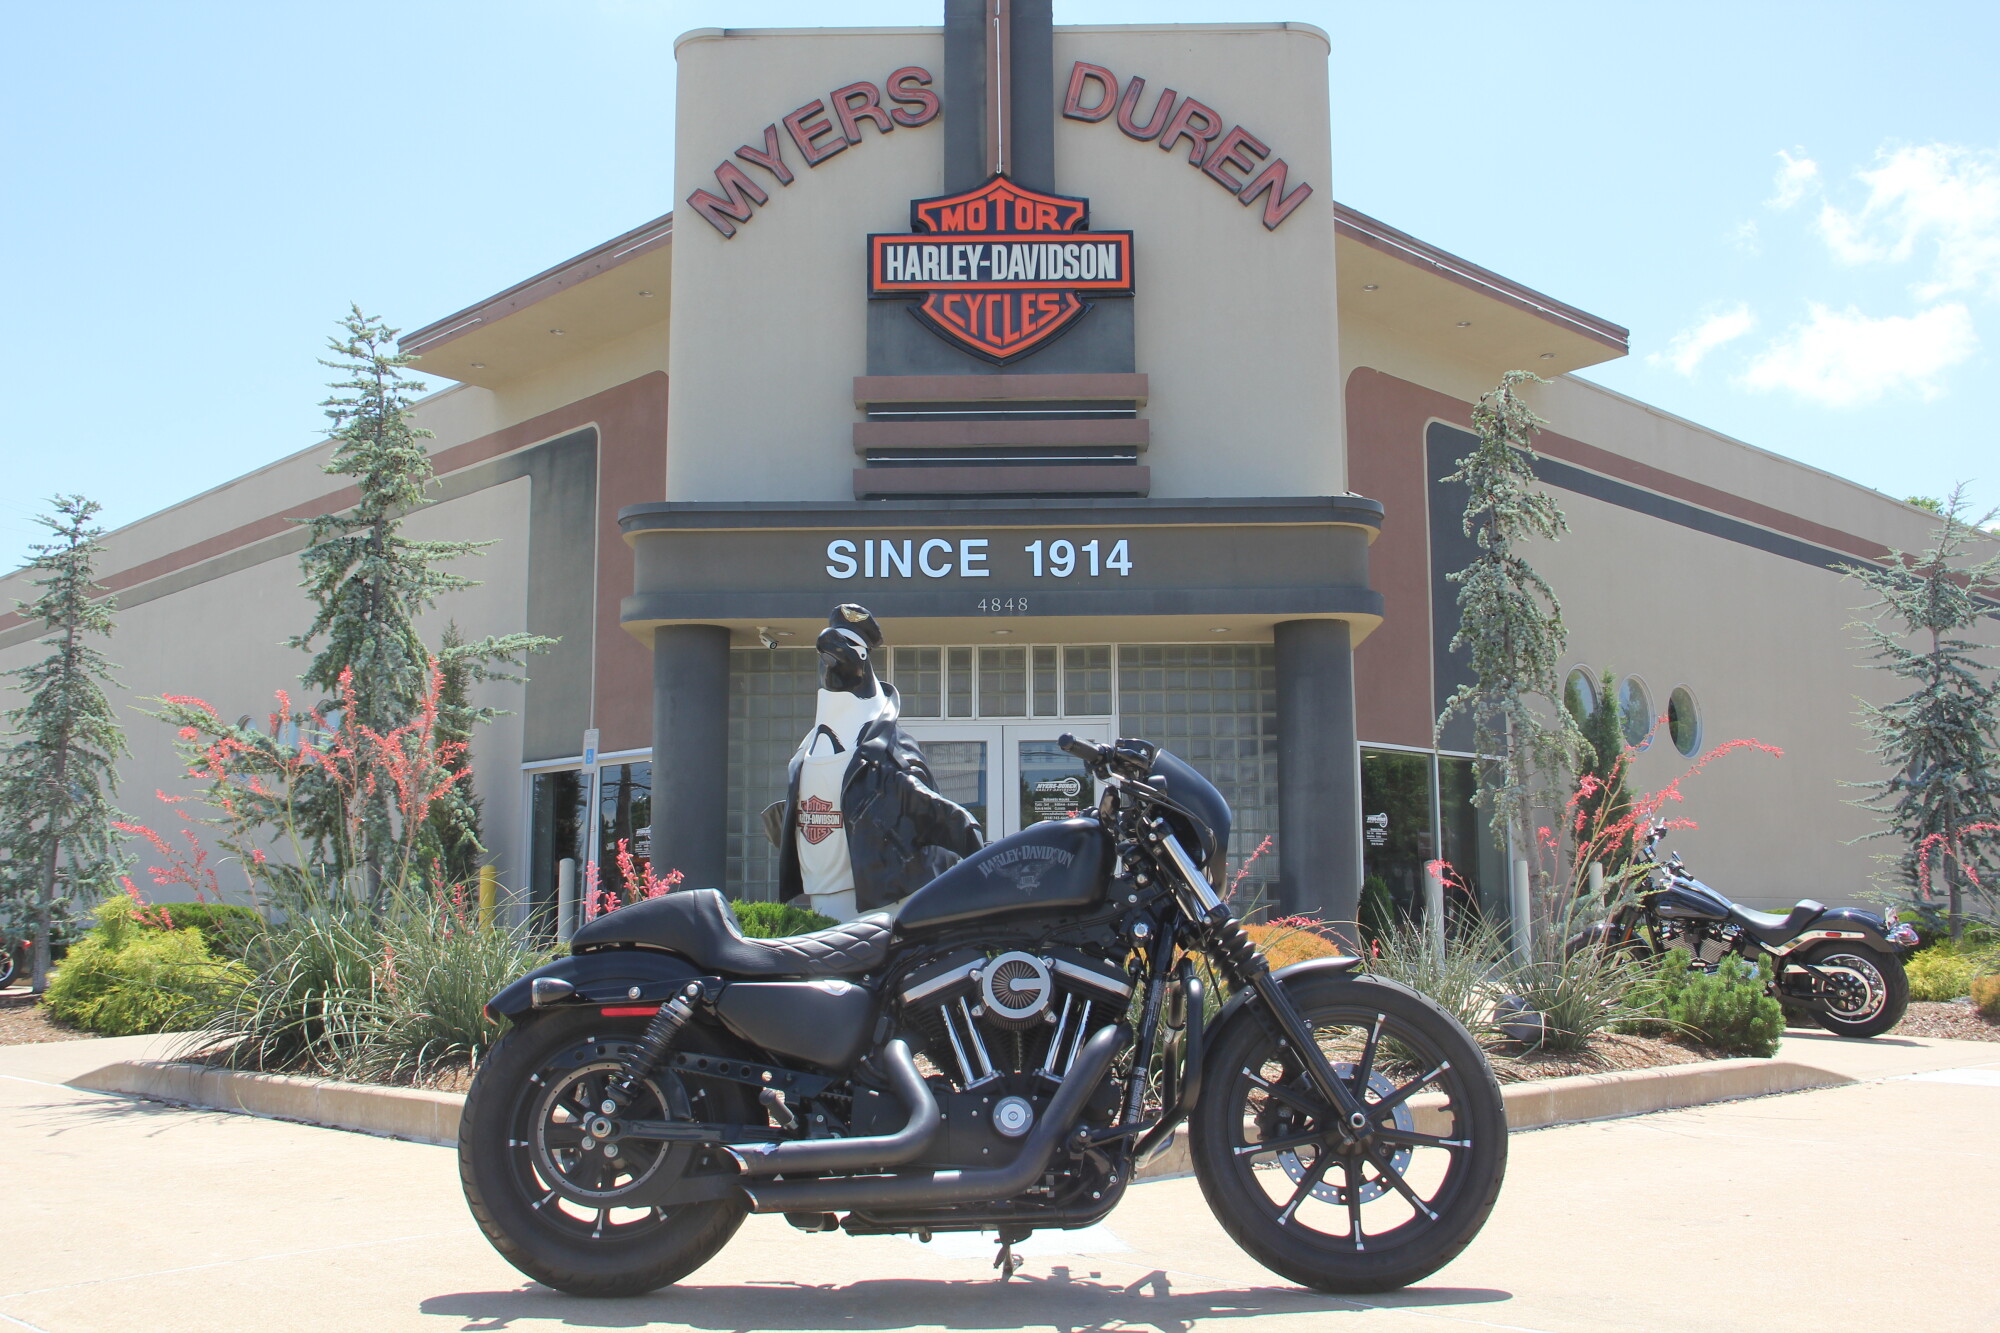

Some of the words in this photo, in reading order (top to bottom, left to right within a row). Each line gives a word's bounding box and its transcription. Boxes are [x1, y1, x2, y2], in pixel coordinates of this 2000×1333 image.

[686, 66, 940, 239] MYERS
[1062, 61, 1313, 232] DUREN
[941, 188, 1063, 231] MOTOR
[886, 243, 1117, 281] HARLEY-DAVIDSON
[943, 293, 1061, 346] CYCLES
[826, 538, 990, 579] SINCE
[1024, 538, 1133, 578] 1914
[977, 597, 1028, 612] 4848
[799, 813, 839, 824] EY-DAVIDSON
